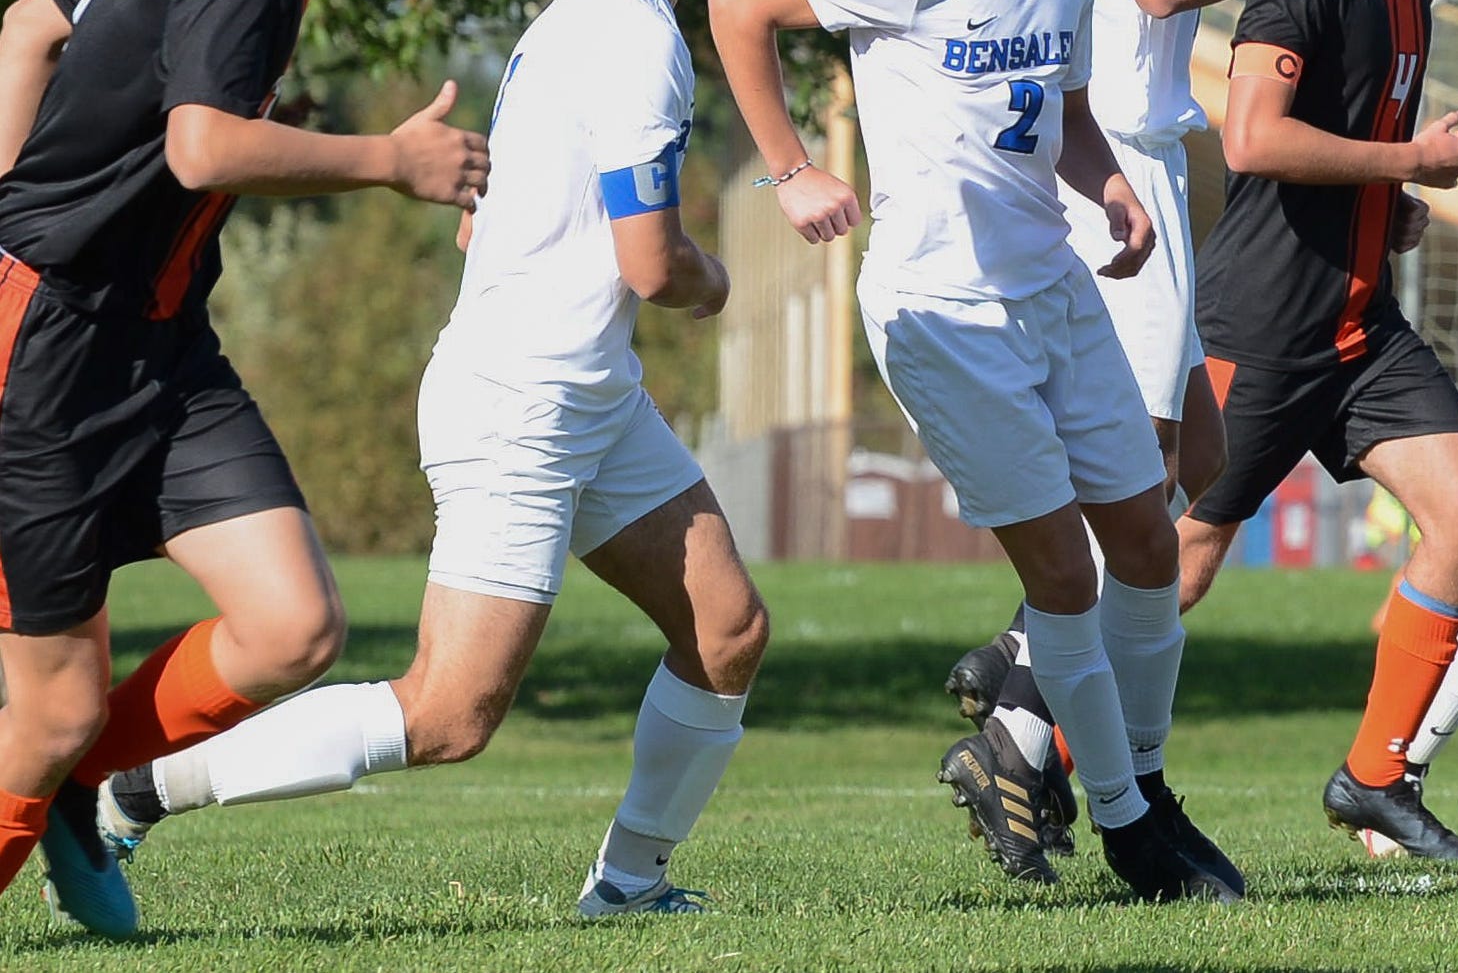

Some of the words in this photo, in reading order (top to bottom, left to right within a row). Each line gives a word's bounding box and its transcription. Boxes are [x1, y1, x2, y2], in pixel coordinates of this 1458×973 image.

[942, 30, 1074, 73] BENSALE
[1275, 54, 1298, 79] C
[993, 78, 1045, 155] 2
[632, 161, 672, 207] C
